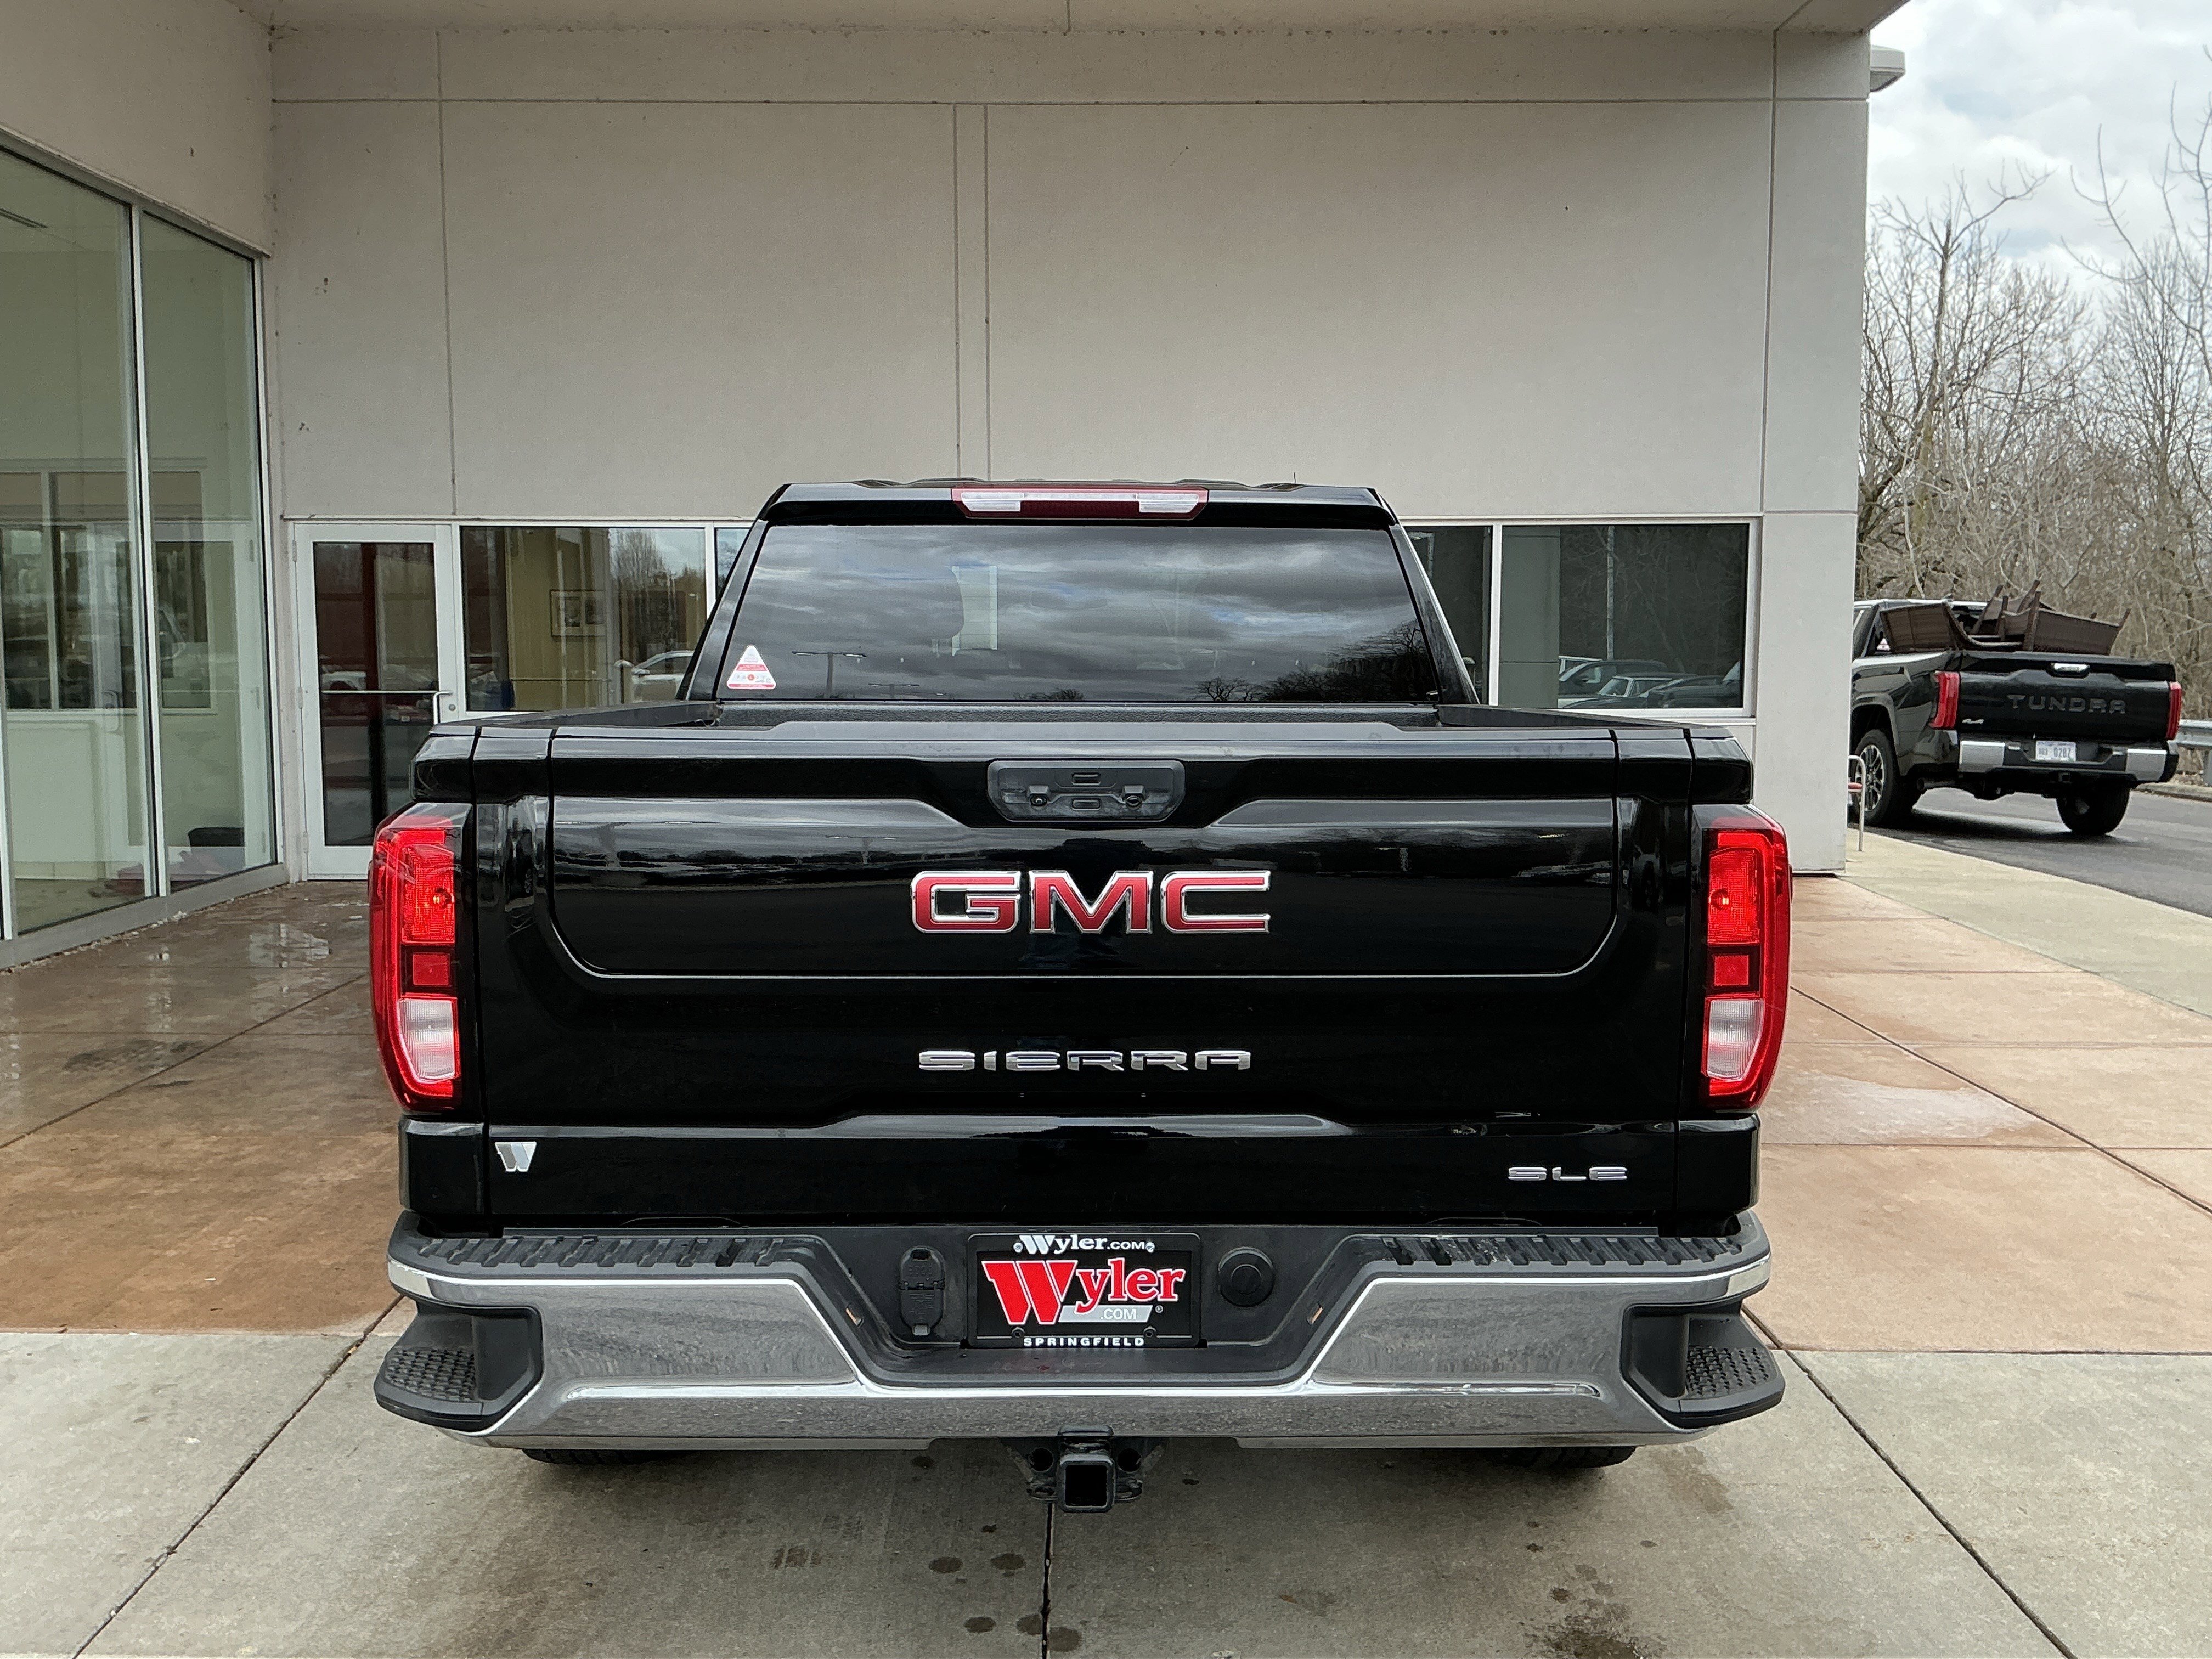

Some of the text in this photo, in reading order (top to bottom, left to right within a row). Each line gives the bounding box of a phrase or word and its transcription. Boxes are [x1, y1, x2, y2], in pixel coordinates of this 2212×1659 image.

[2007, 694, 2126, 714] TUNDRA
[910, 870, 1271, 934] GMC
[918, 1050, 1251, 1071] SIERRA
[1508, 1166, 1627, 1181] SLE
[981, 1257, 1186, 1325] Wyler
[1023, 1337, 1145, 1347] SPRINGFIELD
